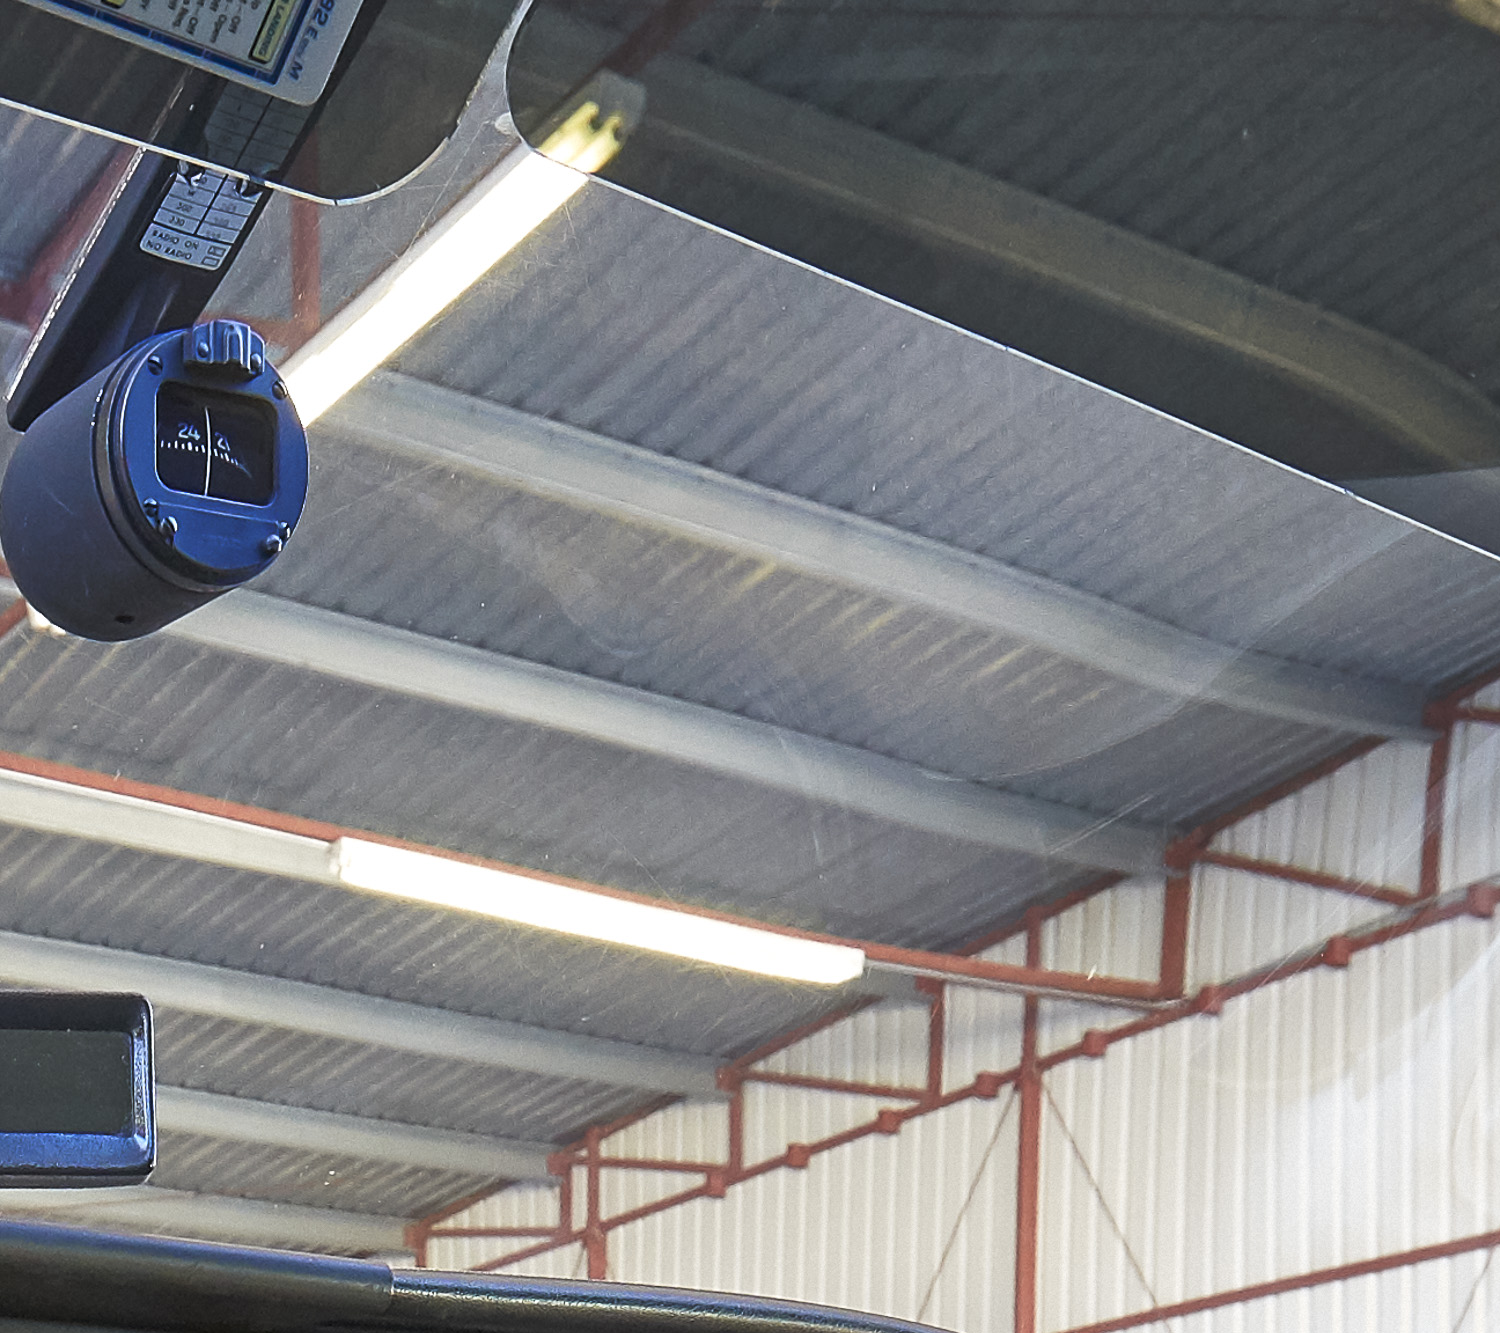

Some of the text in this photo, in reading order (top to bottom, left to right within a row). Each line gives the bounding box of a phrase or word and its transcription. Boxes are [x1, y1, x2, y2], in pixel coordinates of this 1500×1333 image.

[152, 230, 199, 250] RADIO ON
[146, 241, 192, 260] NO RADIO
[178, 423, 200, 440] 24
[215, 432, 231, 451] 21
